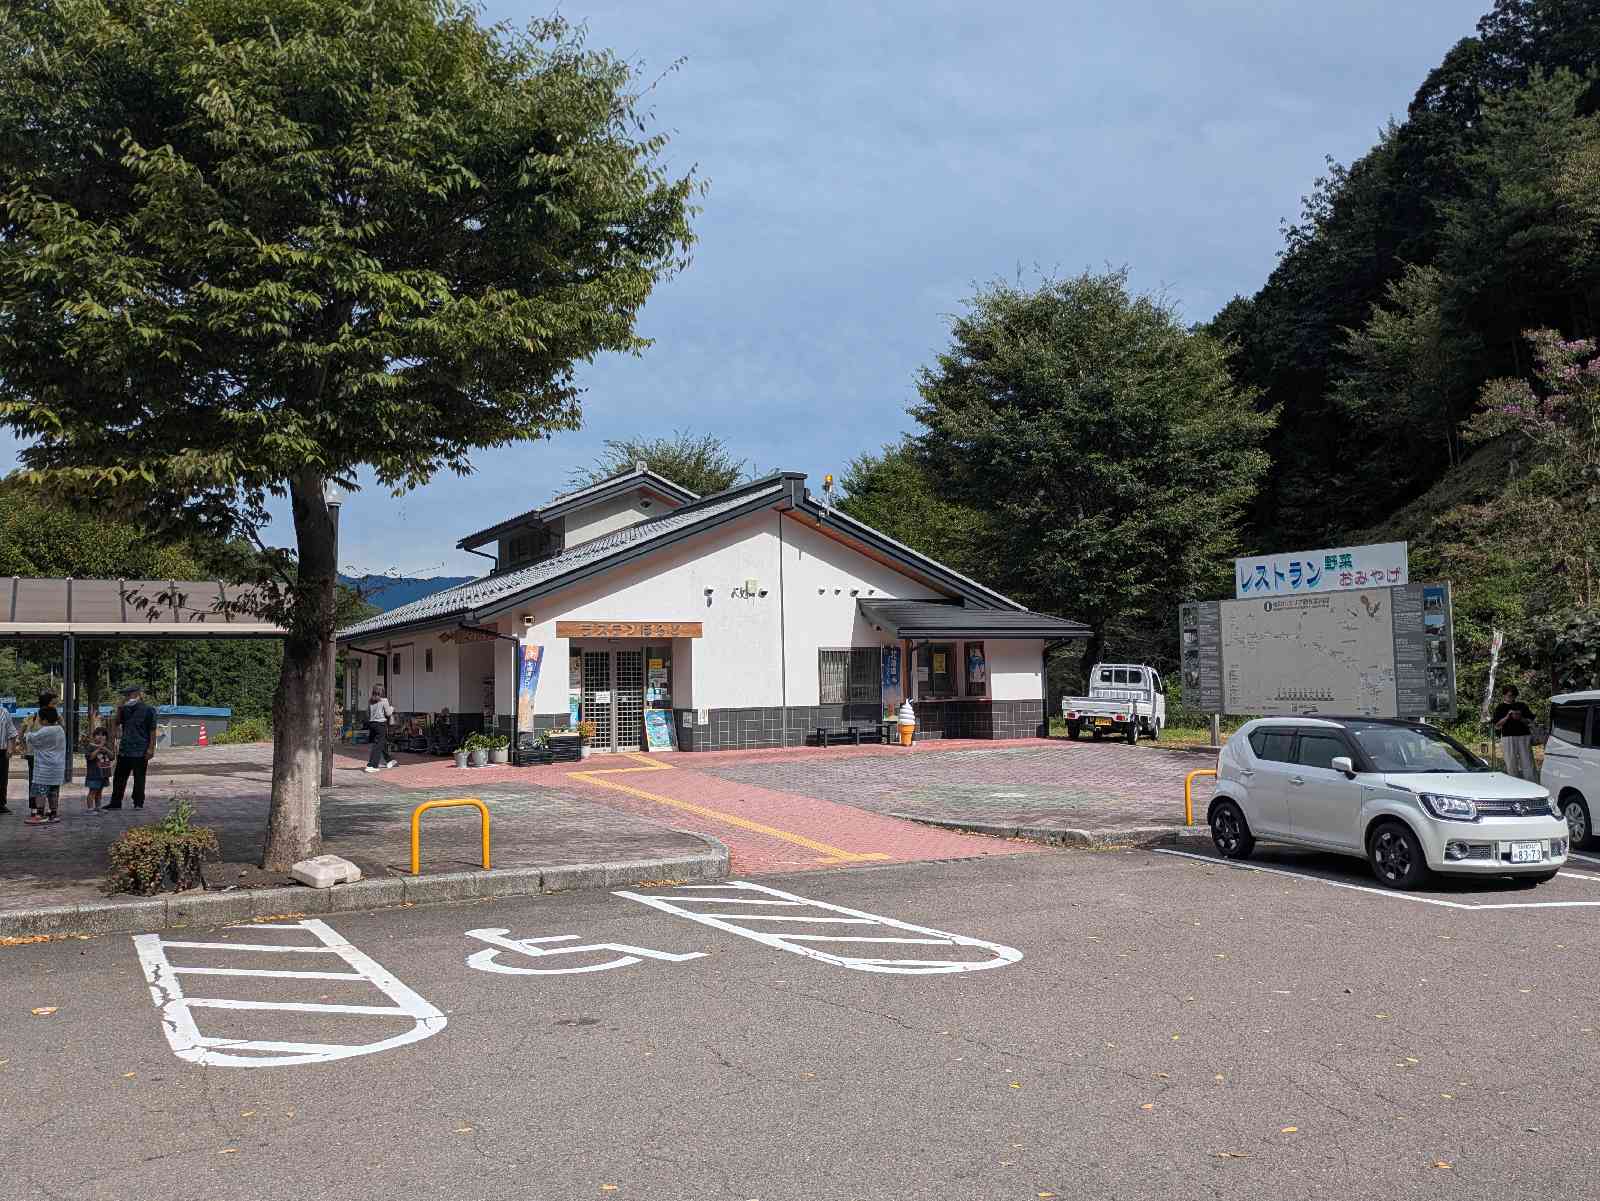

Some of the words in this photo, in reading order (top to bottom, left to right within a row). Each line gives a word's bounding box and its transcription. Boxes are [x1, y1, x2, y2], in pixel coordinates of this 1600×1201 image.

[1324, 553, 1353, 570] 野菜
[1240, 560, 1322, 593] レストラン
[1339, 568, 1402, 587] おみやげ
